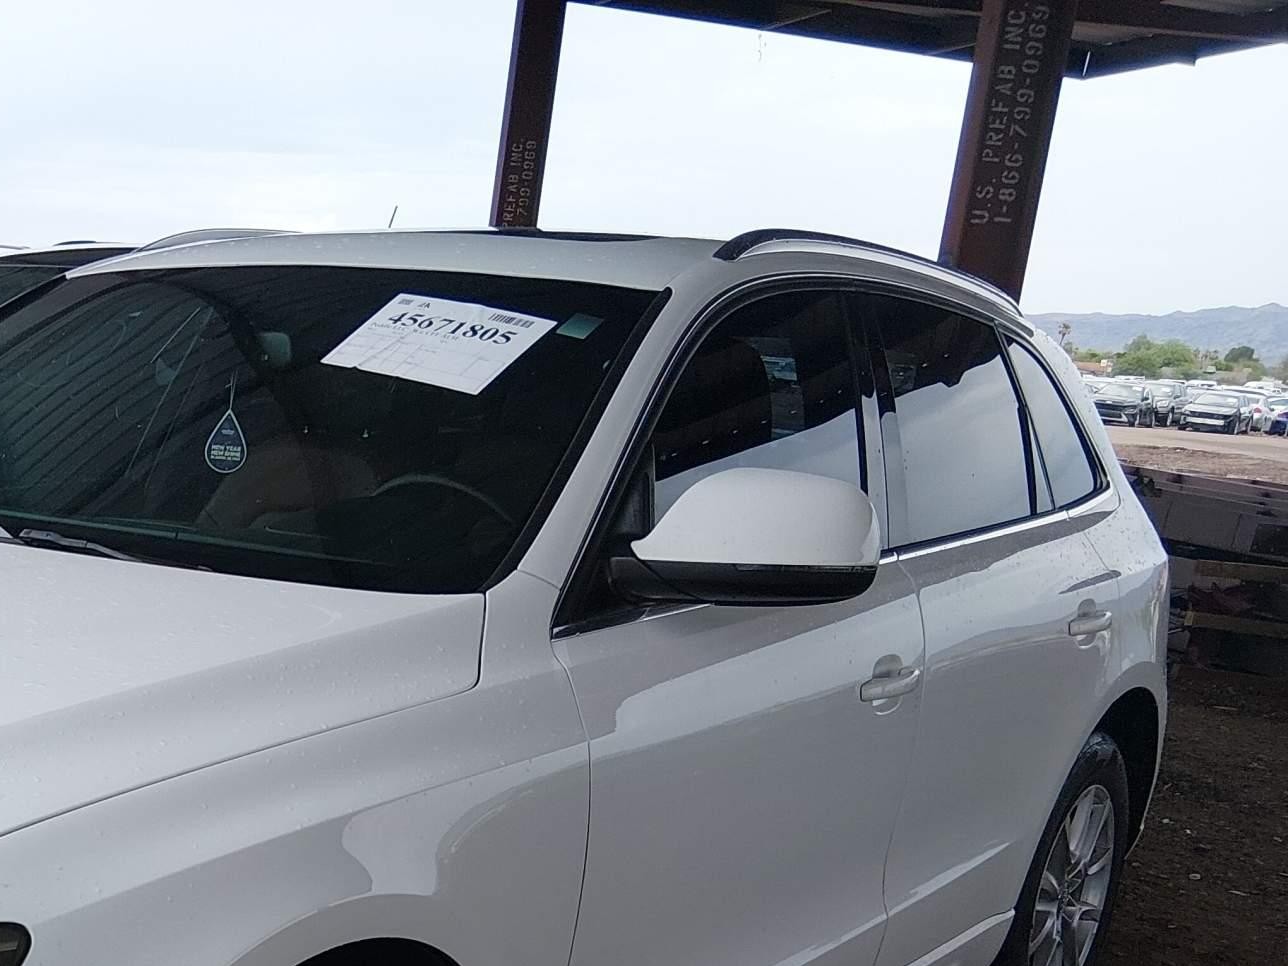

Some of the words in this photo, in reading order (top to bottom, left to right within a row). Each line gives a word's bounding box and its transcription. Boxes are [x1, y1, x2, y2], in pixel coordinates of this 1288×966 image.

[1003, 2, 1029, 50] INC.
[982, 64, 1016, 162] PREFAB
[993, 5, 1051, 223] 1-866-799-0969
[970, 179, 997, 225] U.S.
[387, 311, 520, 345] 45671805
